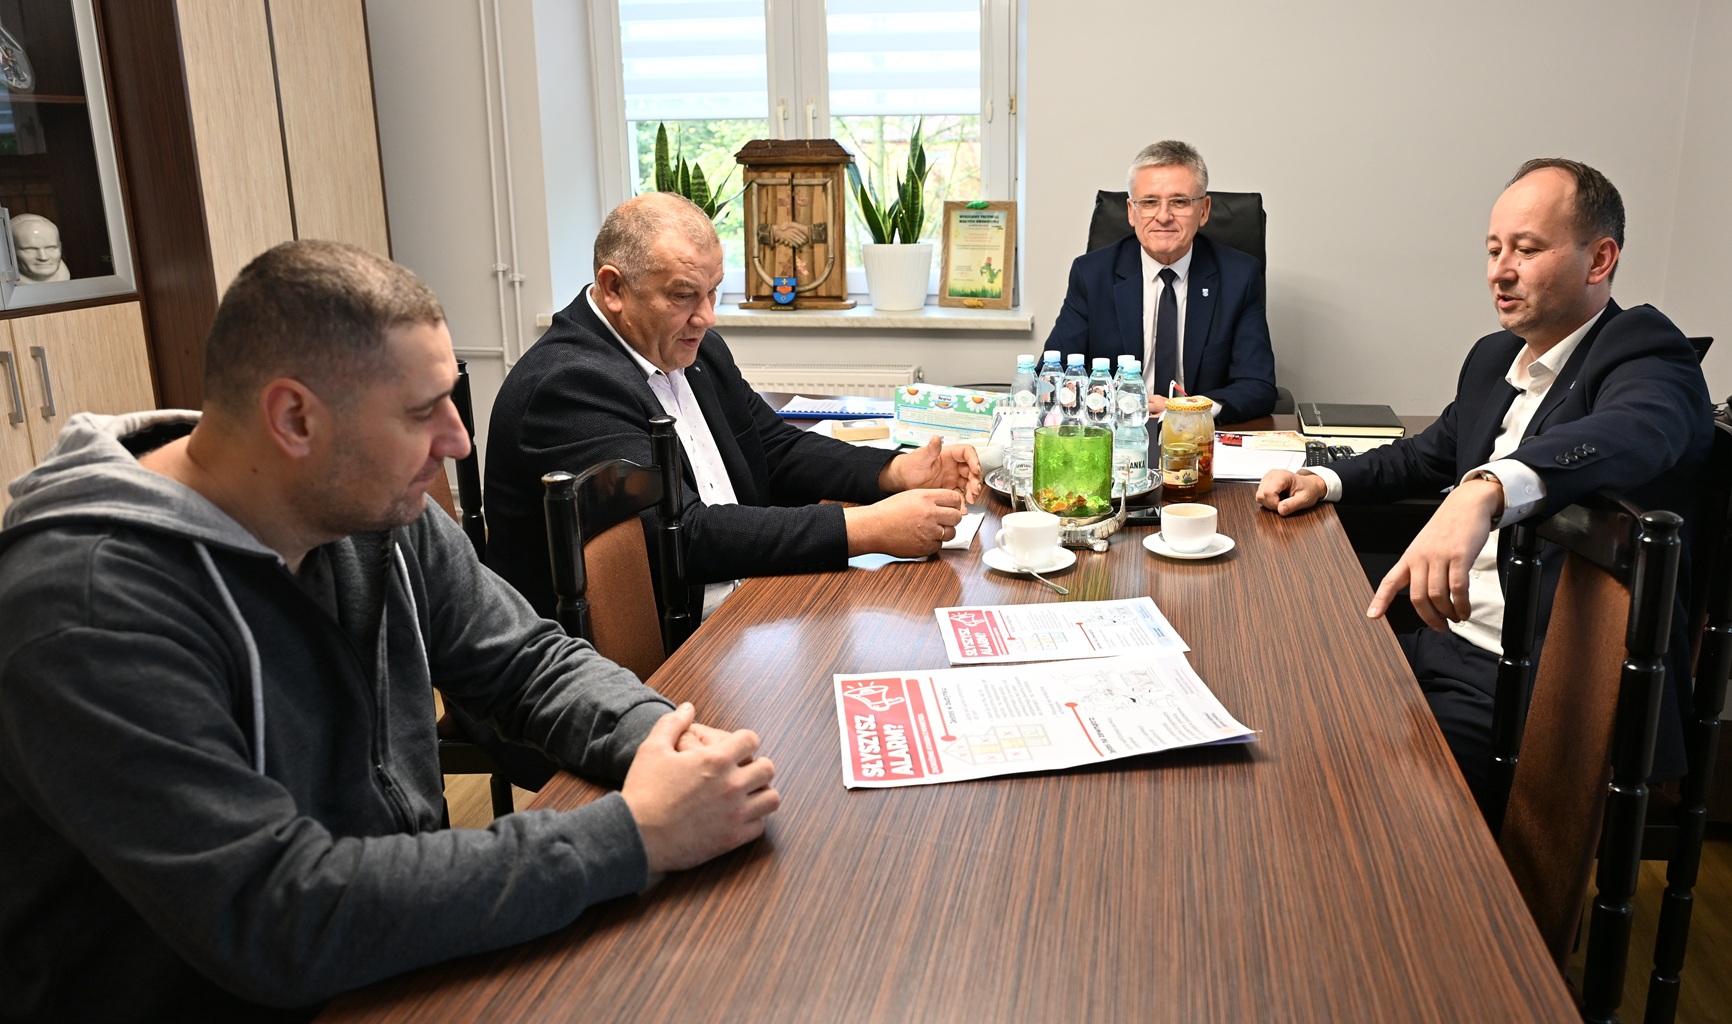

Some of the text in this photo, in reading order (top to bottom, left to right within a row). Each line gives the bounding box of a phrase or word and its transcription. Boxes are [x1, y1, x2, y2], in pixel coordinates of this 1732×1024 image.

[958, 627, 979, 657] SŁYSZYSZ
[974, 632, 994, 656] ALARM?
[854, 714, 885, 777] SŁYSZYSZ
[883, 724, 914, 775] ALARM?
